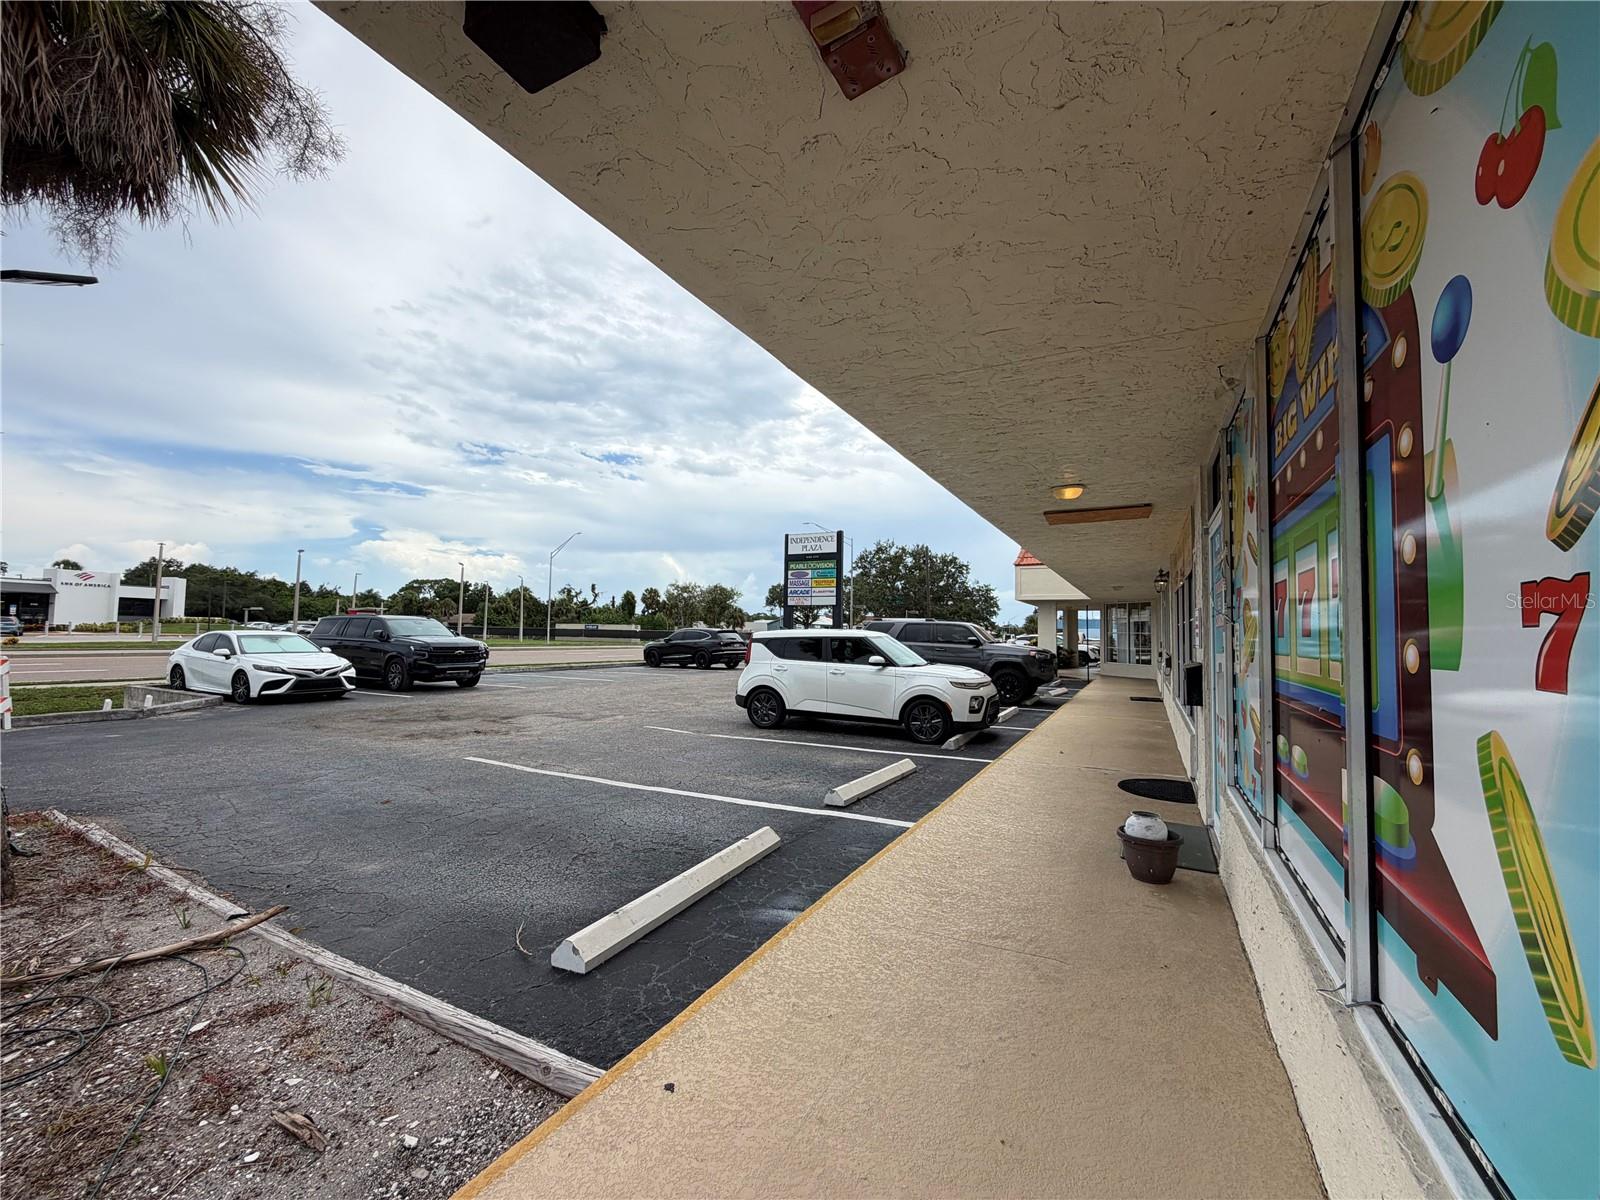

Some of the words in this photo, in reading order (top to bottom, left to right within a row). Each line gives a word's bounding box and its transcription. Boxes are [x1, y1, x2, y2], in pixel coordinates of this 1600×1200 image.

[1274, 403, 1298, 458] BIG
[790, 535, 835, 544] INDEPENDENCE
[1297, 566, 1316, 638] 7
[1520, 571, 1591, 695] 7
